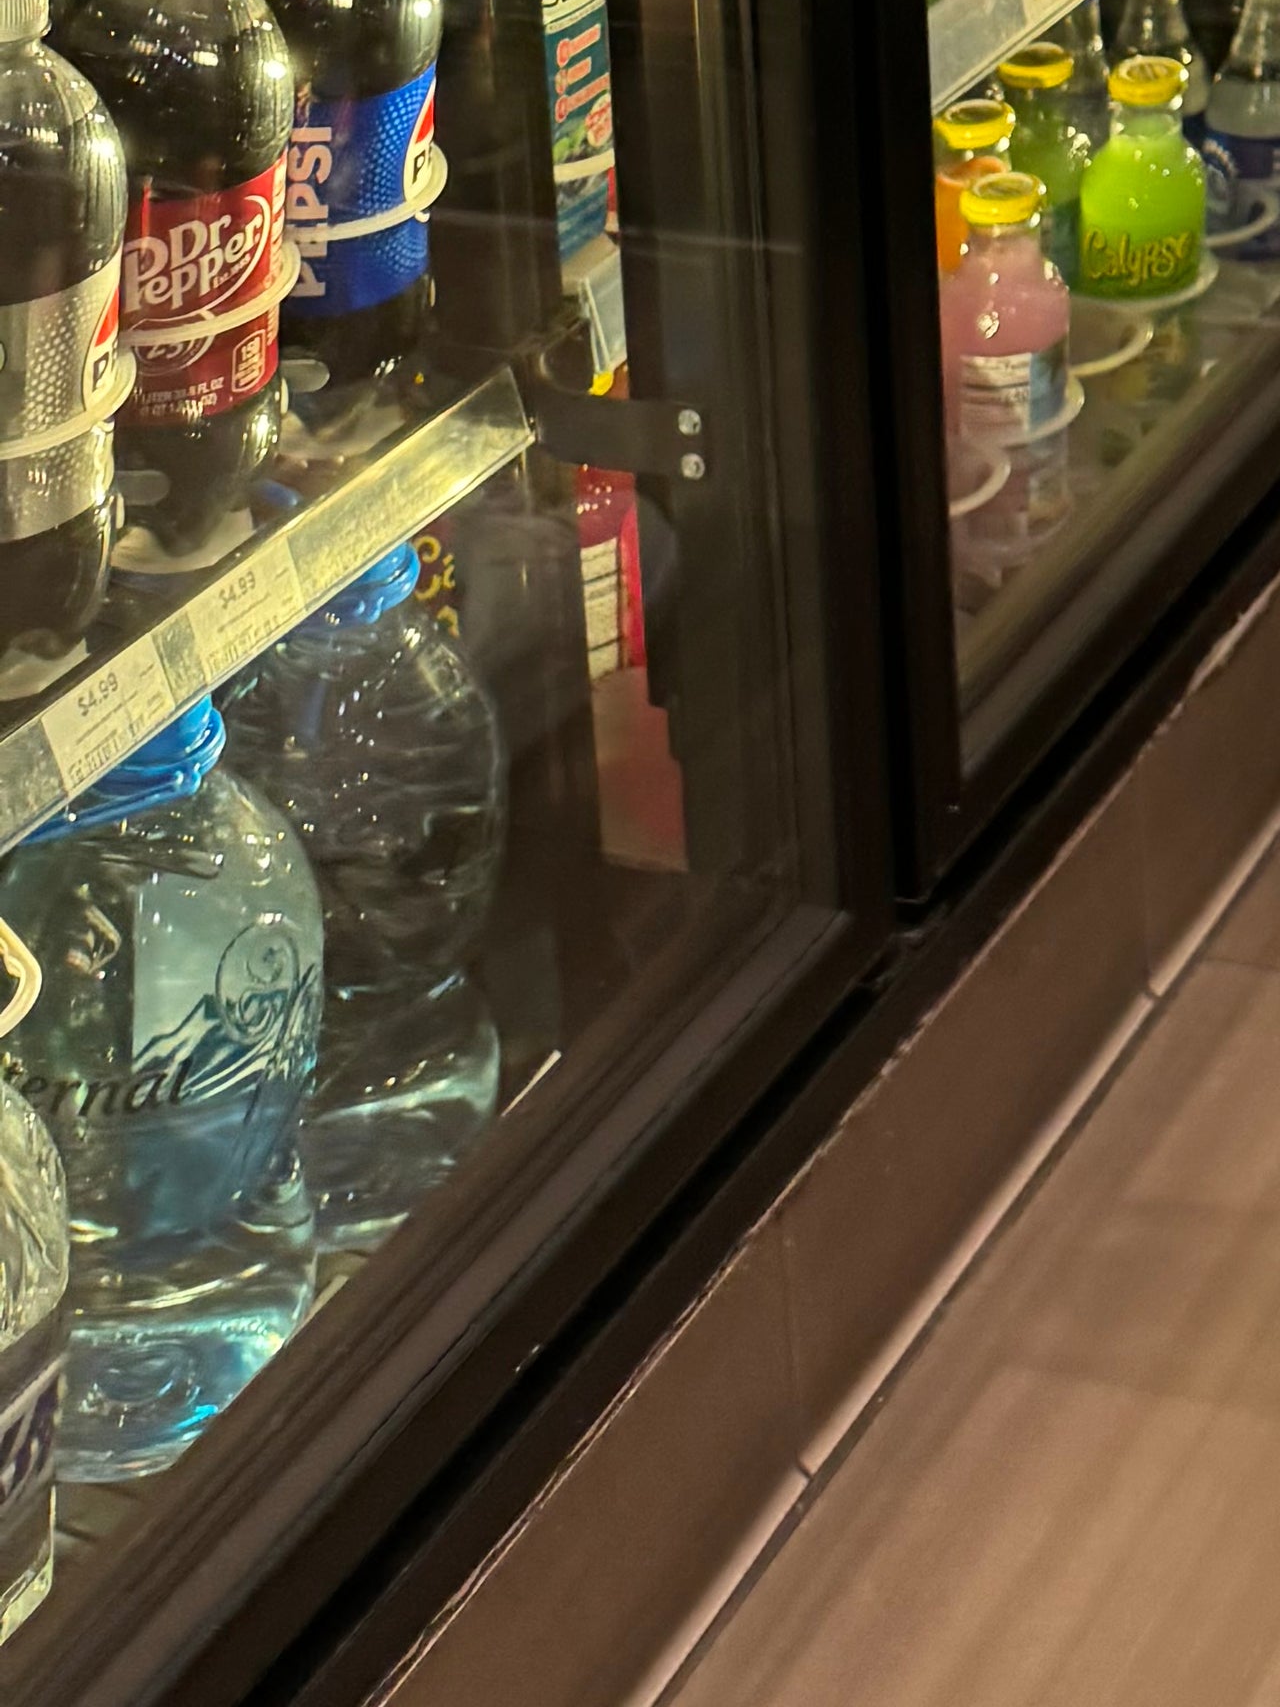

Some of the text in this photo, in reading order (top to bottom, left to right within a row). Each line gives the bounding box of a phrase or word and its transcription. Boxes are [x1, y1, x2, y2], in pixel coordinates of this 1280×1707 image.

[123, 212, 262, 314] Pepper
[169, 213, 232, 272] Dr
[76, 672, 119, 717] $4.99
